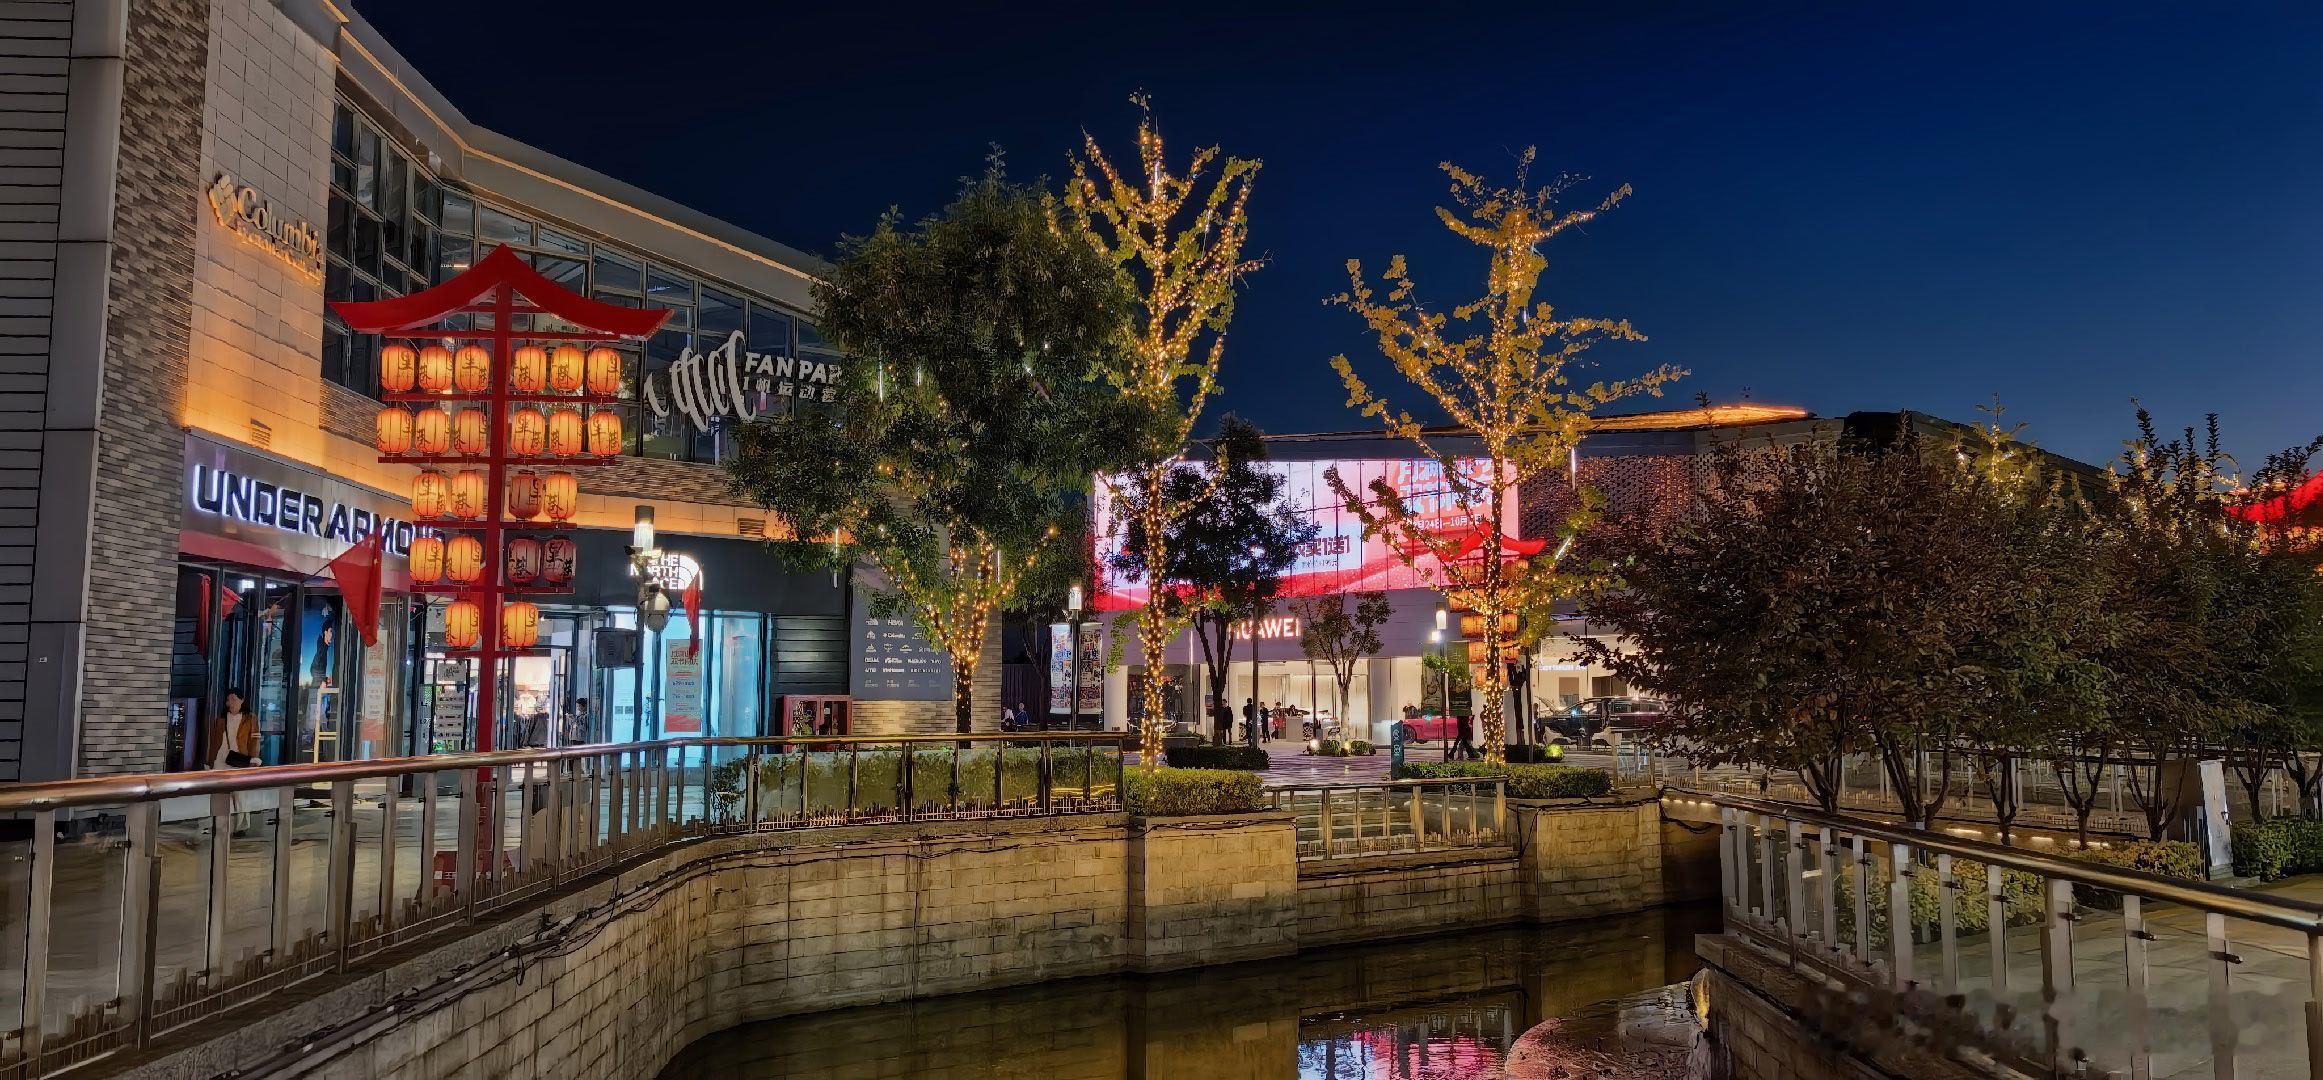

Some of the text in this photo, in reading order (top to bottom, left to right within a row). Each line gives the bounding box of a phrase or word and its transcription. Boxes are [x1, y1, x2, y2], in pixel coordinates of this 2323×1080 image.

[744, 351, 795, 378] FAN
[193, 464, 445, 558] UNDER ARMO
